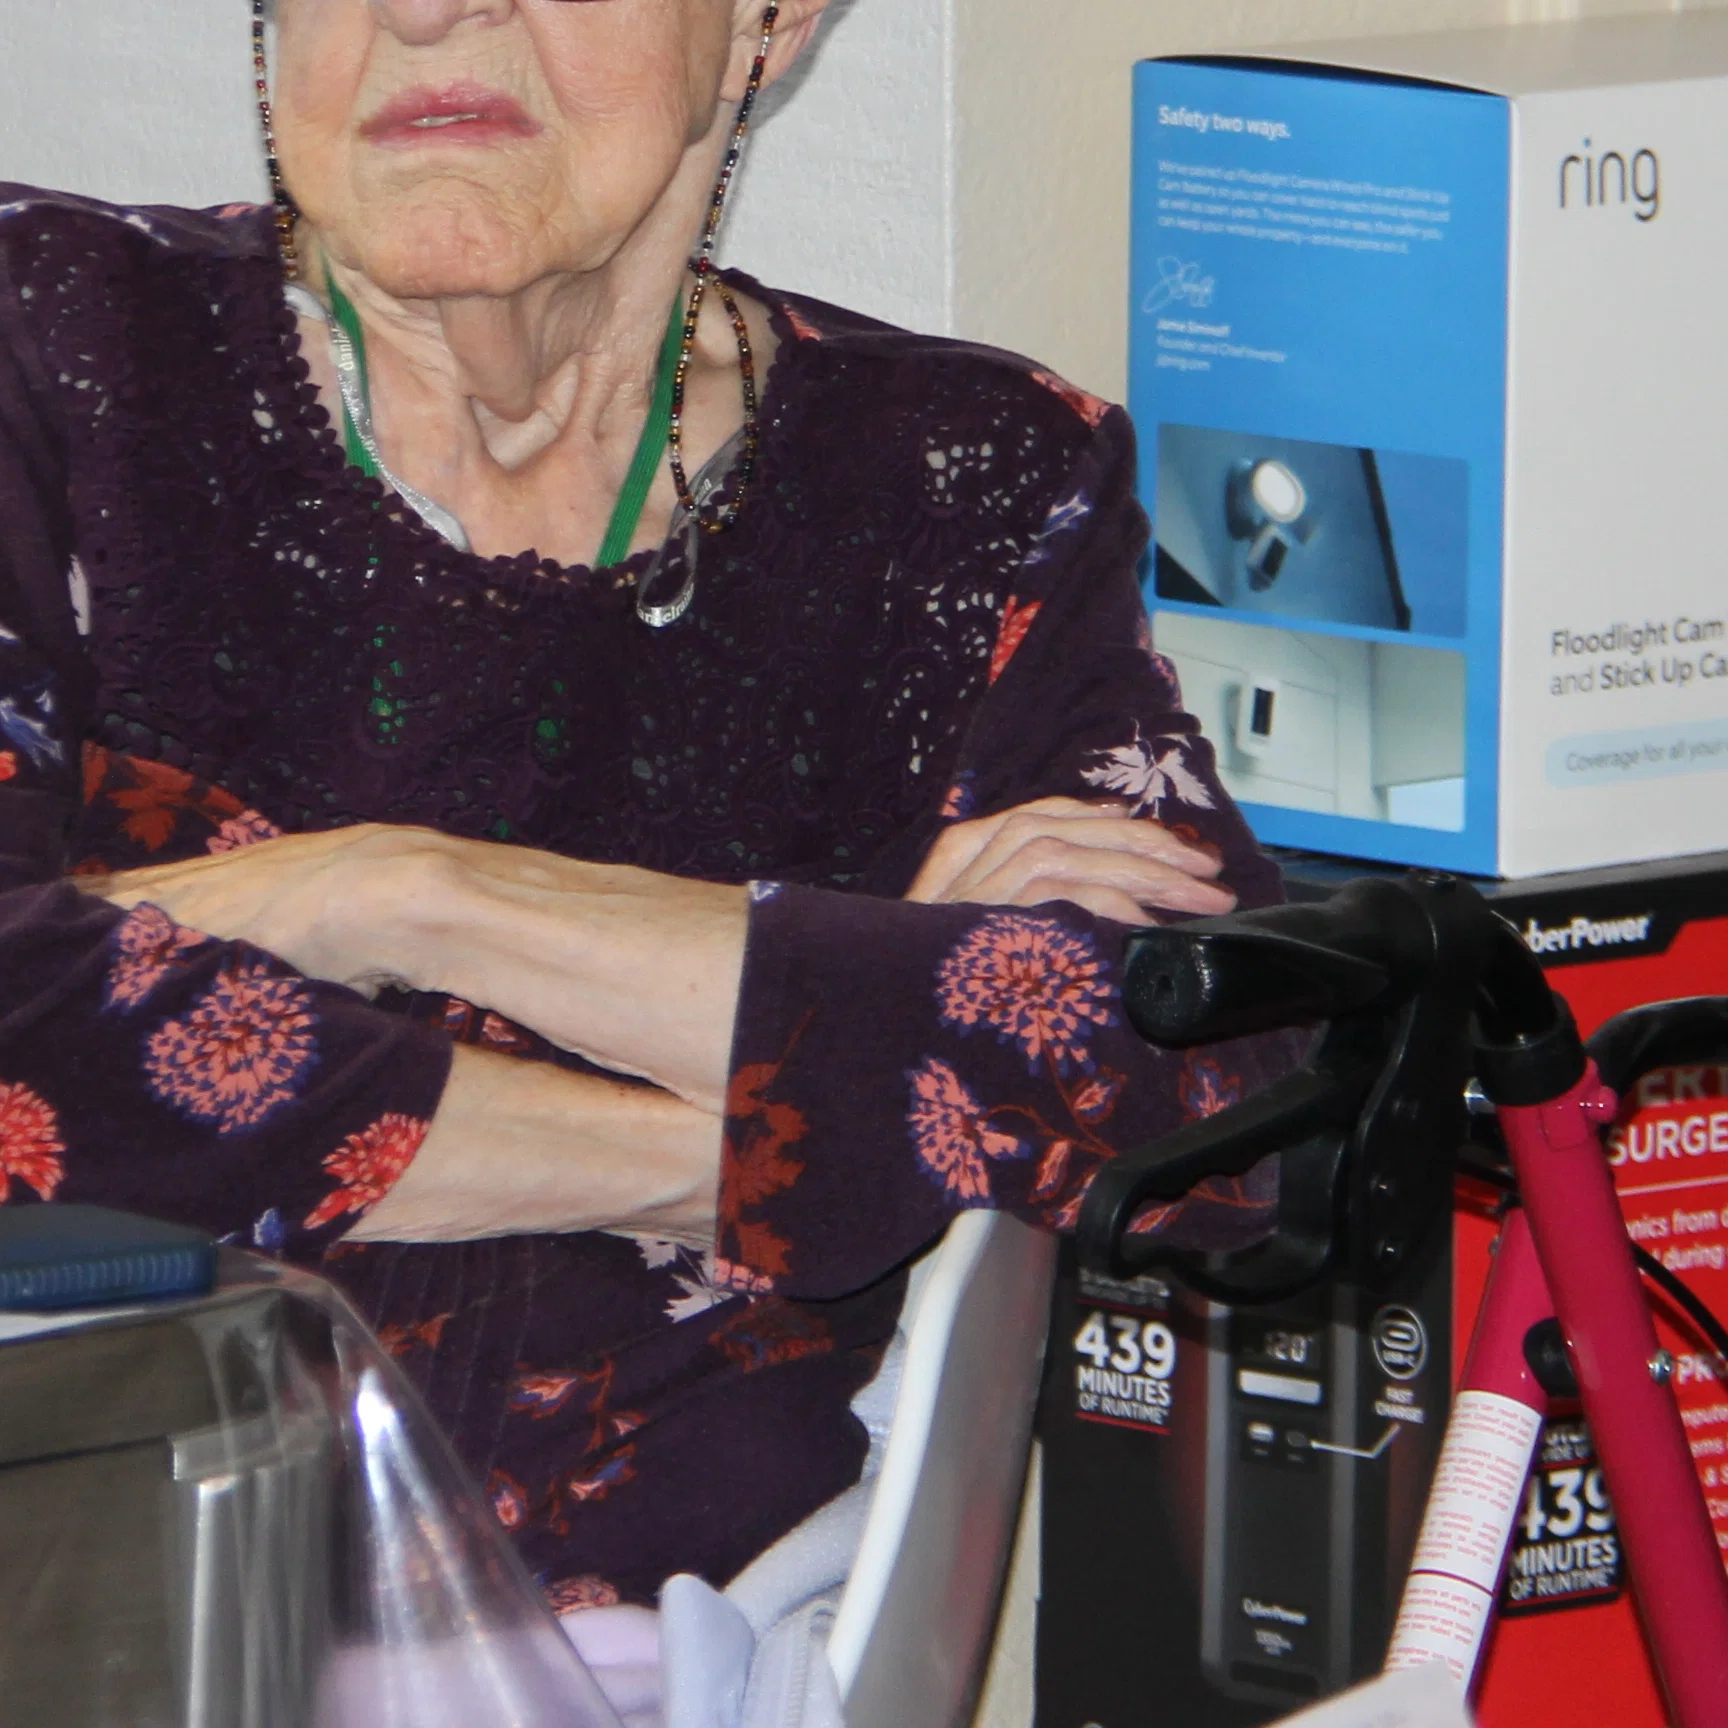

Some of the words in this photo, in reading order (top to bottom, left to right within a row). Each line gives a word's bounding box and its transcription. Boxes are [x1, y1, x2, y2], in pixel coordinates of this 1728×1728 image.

[1159, 104, 1209, 133] Safety
[1212, 113, 1243, 133] two
[1246, 120, 1291, 141] ways.
[1559, 137, 1661, 222] ring
[1551, 621, 1669, 656] Floodlight
[1673, 617, 1723, 643] Cam
[1550, 669, 1593, 696] and
[1600, 660, 1655, 690] Stick
[1661, 657, 1693, 686] Up
[1567, 747, 1640, 771] Coverage
[1643, 742, 1665, 762] for
[1668, 739, 1686, 760] all
[1689, 740, 1722, 762] your
[1524, 915, 1656, 953] berPower
[1672, 1209, 1718, 1235] from
[1663, 1242, 1725, 1270] during
[1074, 1311, 1176, 1380] 439
[1077, 1365, 1171, 1407] MINUTES
[1079, 1392, 1098, 1411] OF
[1385, 1385, 1414, 1405] FAST
[1374, 1400, 1424, 1423] CHARGE
[1705, 1466, 1718, 1487] &
[1510, 1534, 1618, 1579] MINUTES
[1510, 1576, 1533, 1601] OF
